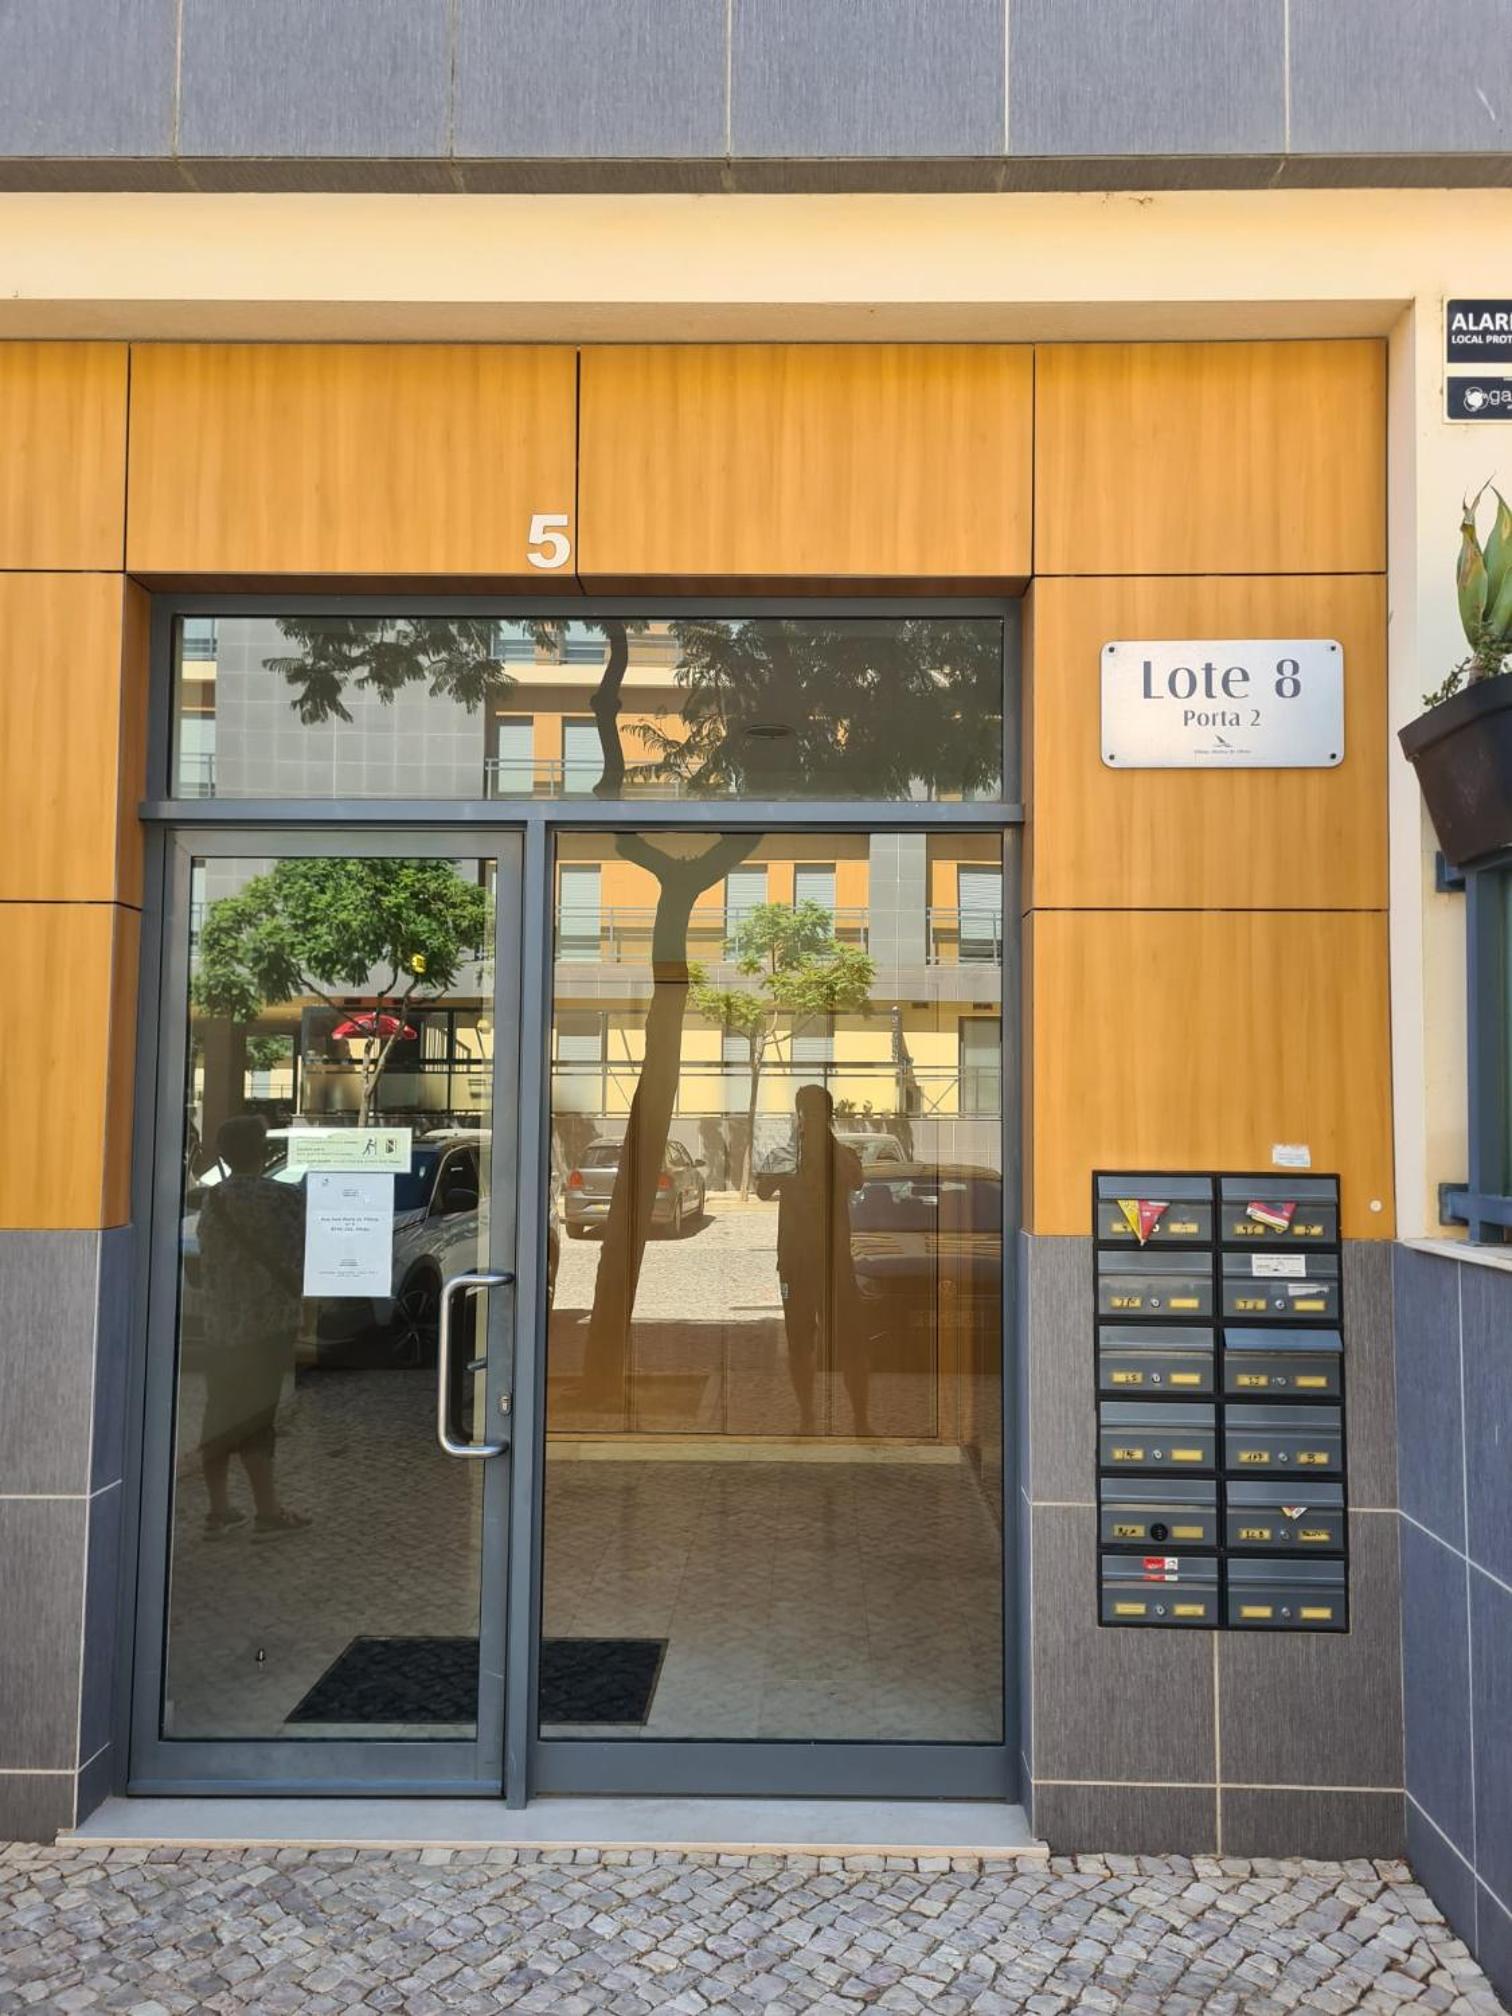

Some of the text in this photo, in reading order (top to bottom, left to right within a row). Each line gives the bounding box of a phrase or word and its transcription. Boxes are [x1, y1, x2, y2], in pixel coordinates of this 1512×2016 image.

[1451, 312, 1512, 331] ALAR
[1451, 334, 1484, 344] LOCAL
[526, 513, 571, 568] 5
[1142, 658, 1302, 700] Lote 8
[1183, 709, 1261, 727] Porta 2
